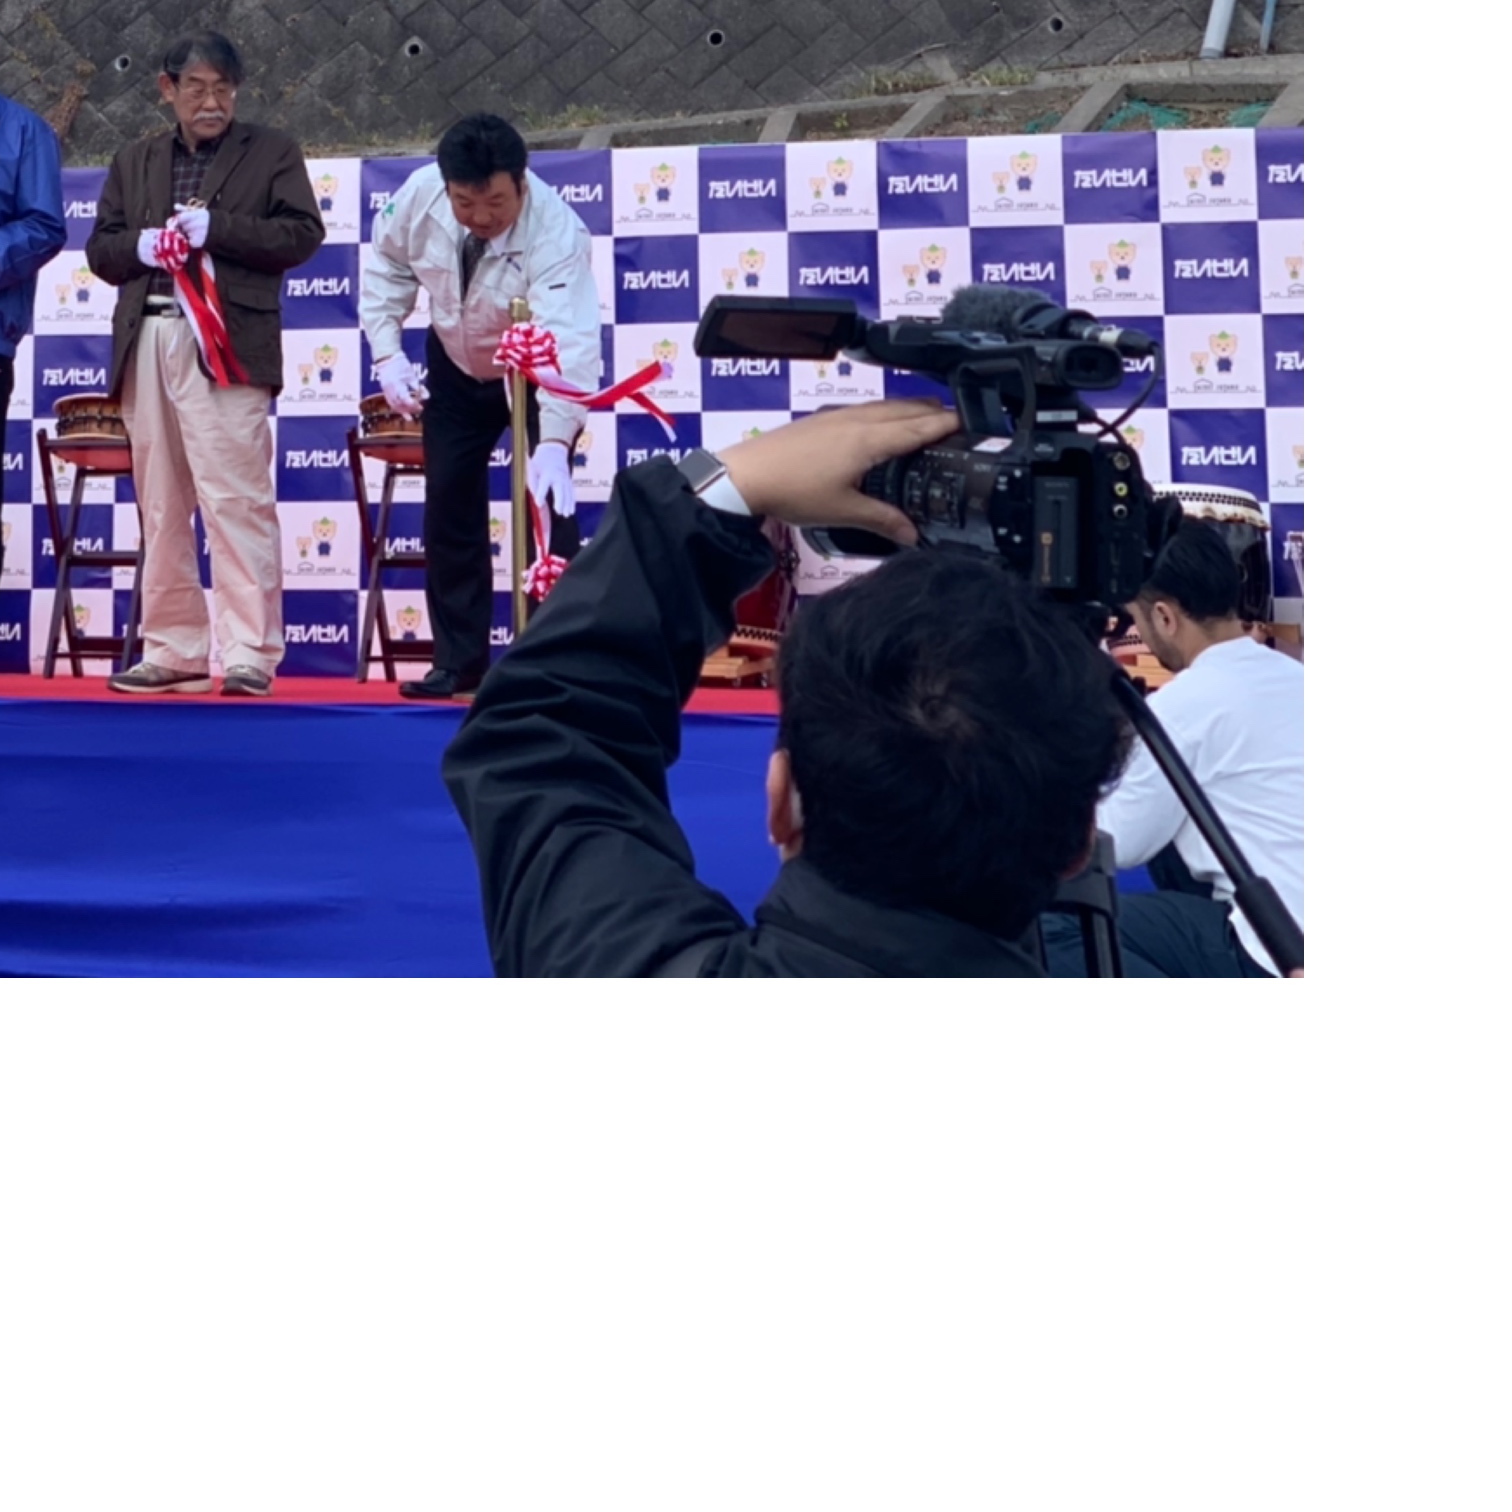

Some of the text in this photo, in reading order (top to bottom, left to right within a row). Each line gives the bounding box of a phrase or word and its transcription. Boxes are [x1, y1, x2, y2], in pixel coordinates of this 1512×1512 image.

[708, 178, 777, 199] たいせい
[888, 173, 958, 195] たいせい
[1074, 167, 1148, 189] たいせい
[554, 182, 603, 203] いせい
[798, 265, 869, 286] たいせい
[981, 261, 1056, 282] たいせい
[1173, 258, 1248, 278] たいせい
[287, 276, 350, 297] たいせい
[622, 269, 689, 290] たいせい
[43, 368, 106, 386] たいせい
[711, 358, 780, 377] たいせい
[285, 449, 350, 468] たいせい
[1181, 446, 1257, 466] たいせい
[285, 624, 349, 643] たいせい
